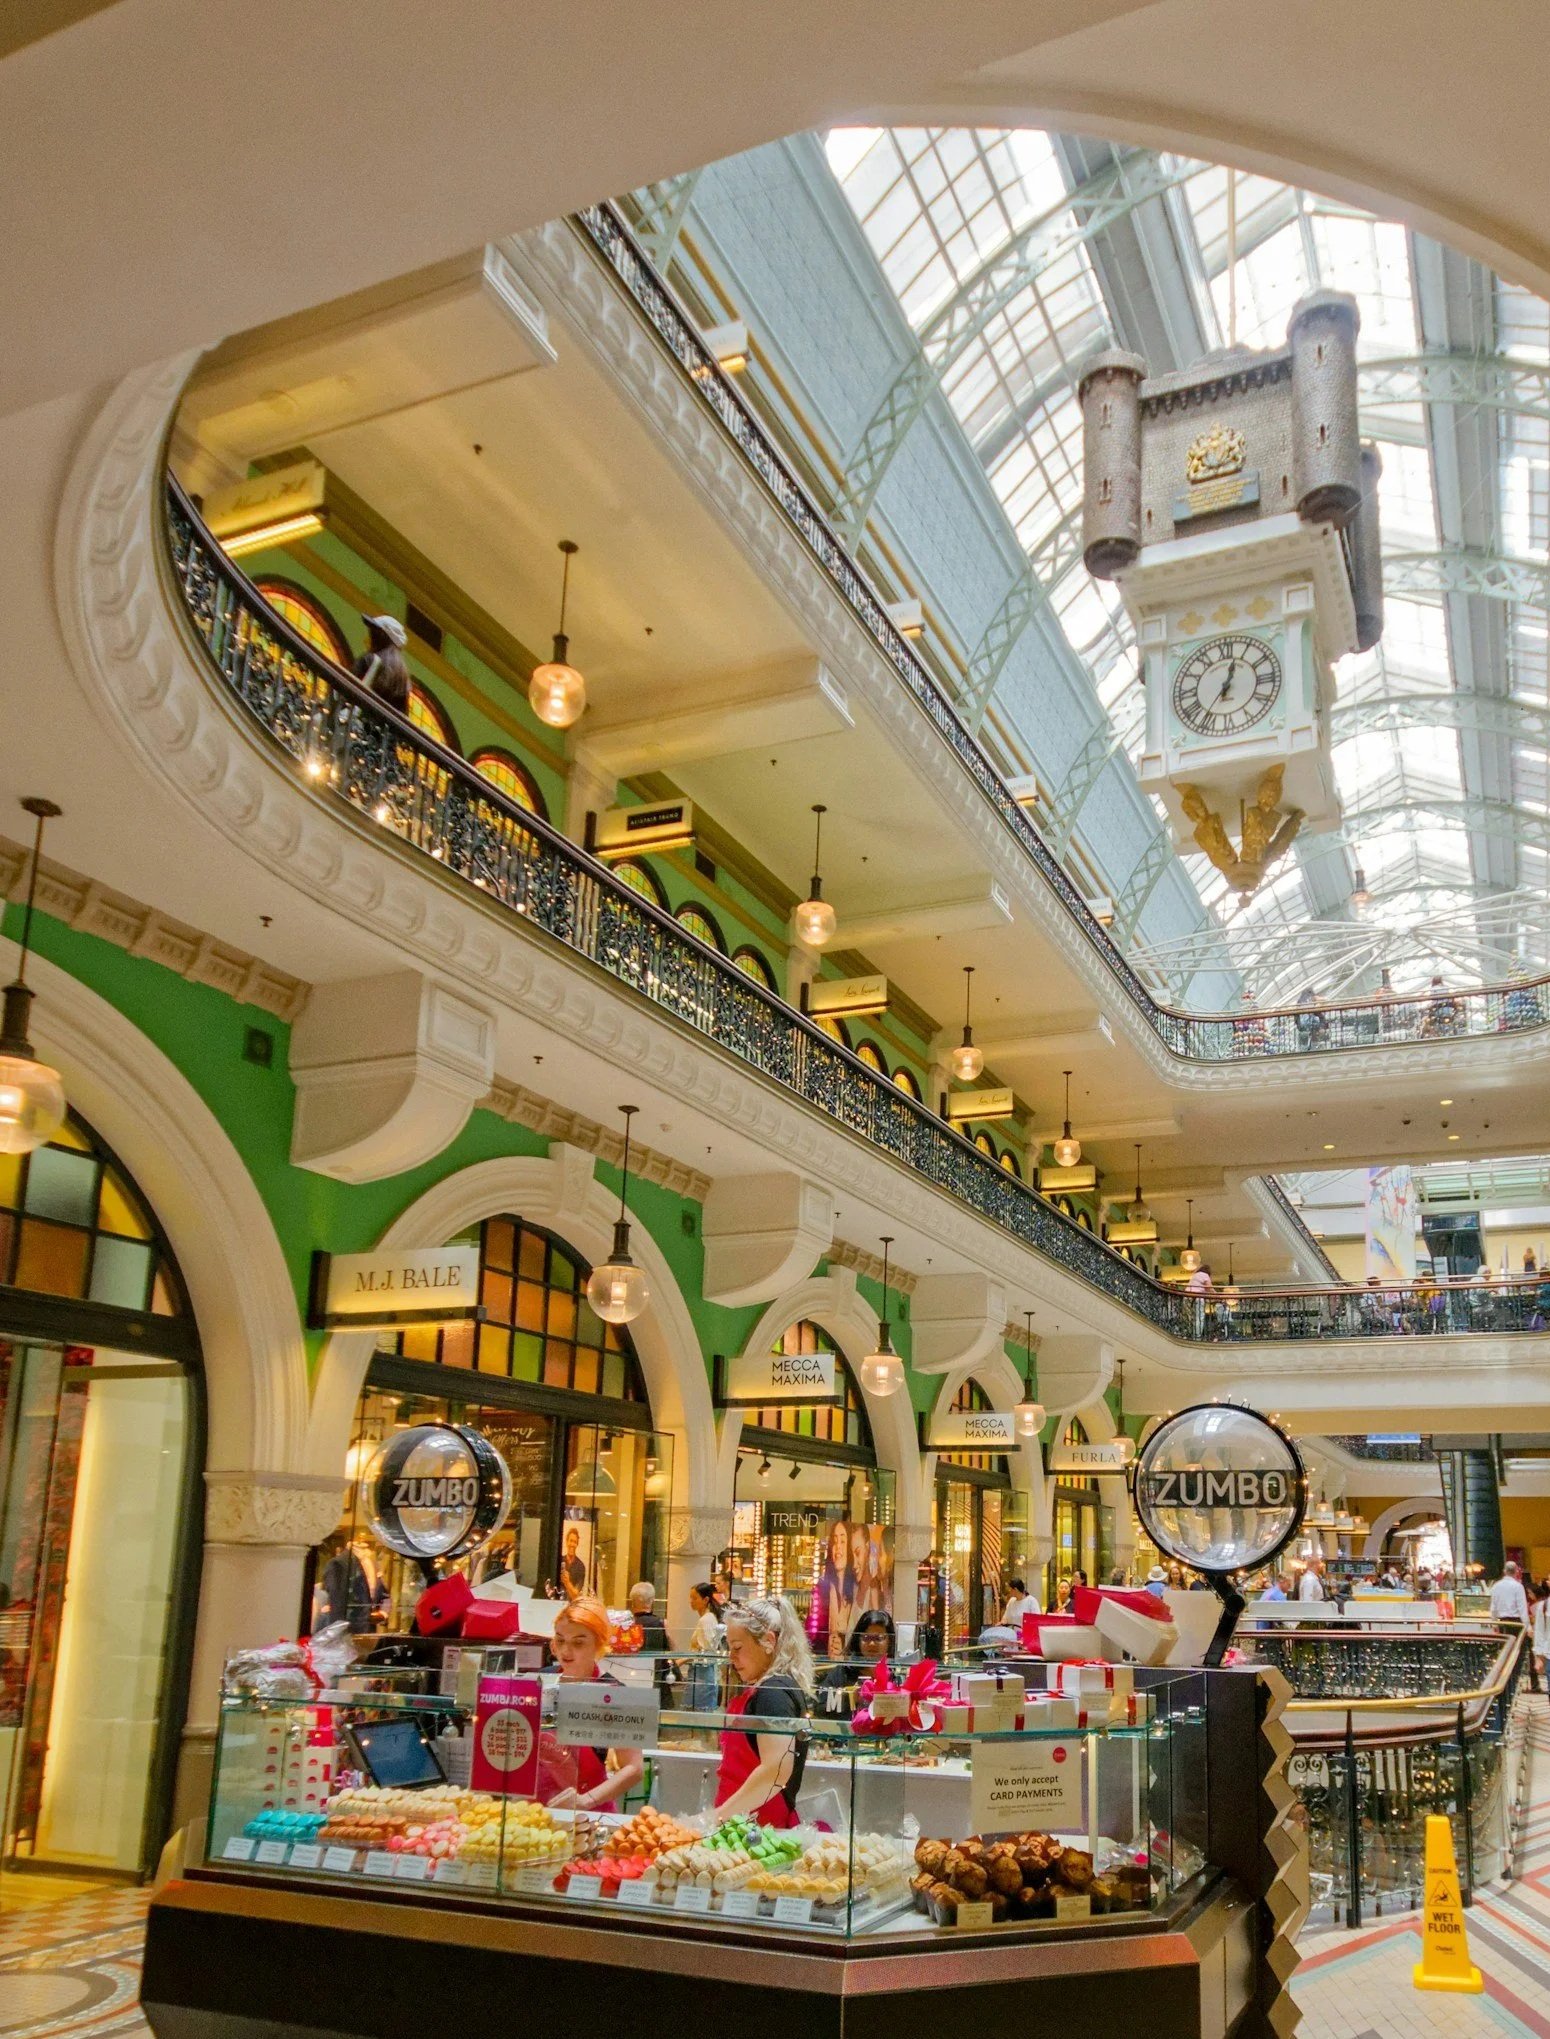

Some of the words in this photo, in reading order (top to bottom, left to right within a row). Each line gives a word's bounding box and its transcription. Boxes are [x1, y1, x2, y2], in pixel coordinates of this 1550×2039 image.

[355, 1270, 394, 1292] M.J.
[401, 1265, 461, 1289] BALE
[772, 1359, 821, 1372] MECCA
[772, 1373, 826, 1386] MAXIMA
[965, 1418, 1005, 1429] MECCA
[965, 1430, 1009, 1439] MAXIMA
[1072, 1452, 1117, 1463] FURLA
[391, 1478, 479, 1506] ZUMBO
[1155, 1471, 1286, 1506] ZUMBO
[771, 1512, 819, 1528] TREND
[568, 1711, 580, 1720] NO
[581, 1712, 602, 1722] CASH,
[603, 1713, 624, 1723] CARD
[625, 1715, 645, 1724] ONLY
[994, 1777, 1009, 1786] We
[1011, 1776, 1030, 1787] only
[1031, 1775, 1059, 1785] accept
[990, 1791, 1014, 1801] CARD
[1016, 1788, 1063, 1799] PAYMENTS
[1433, 1911, 1454, 1922] WET
[1428, 1923, 1461, 1934] FLOOR
